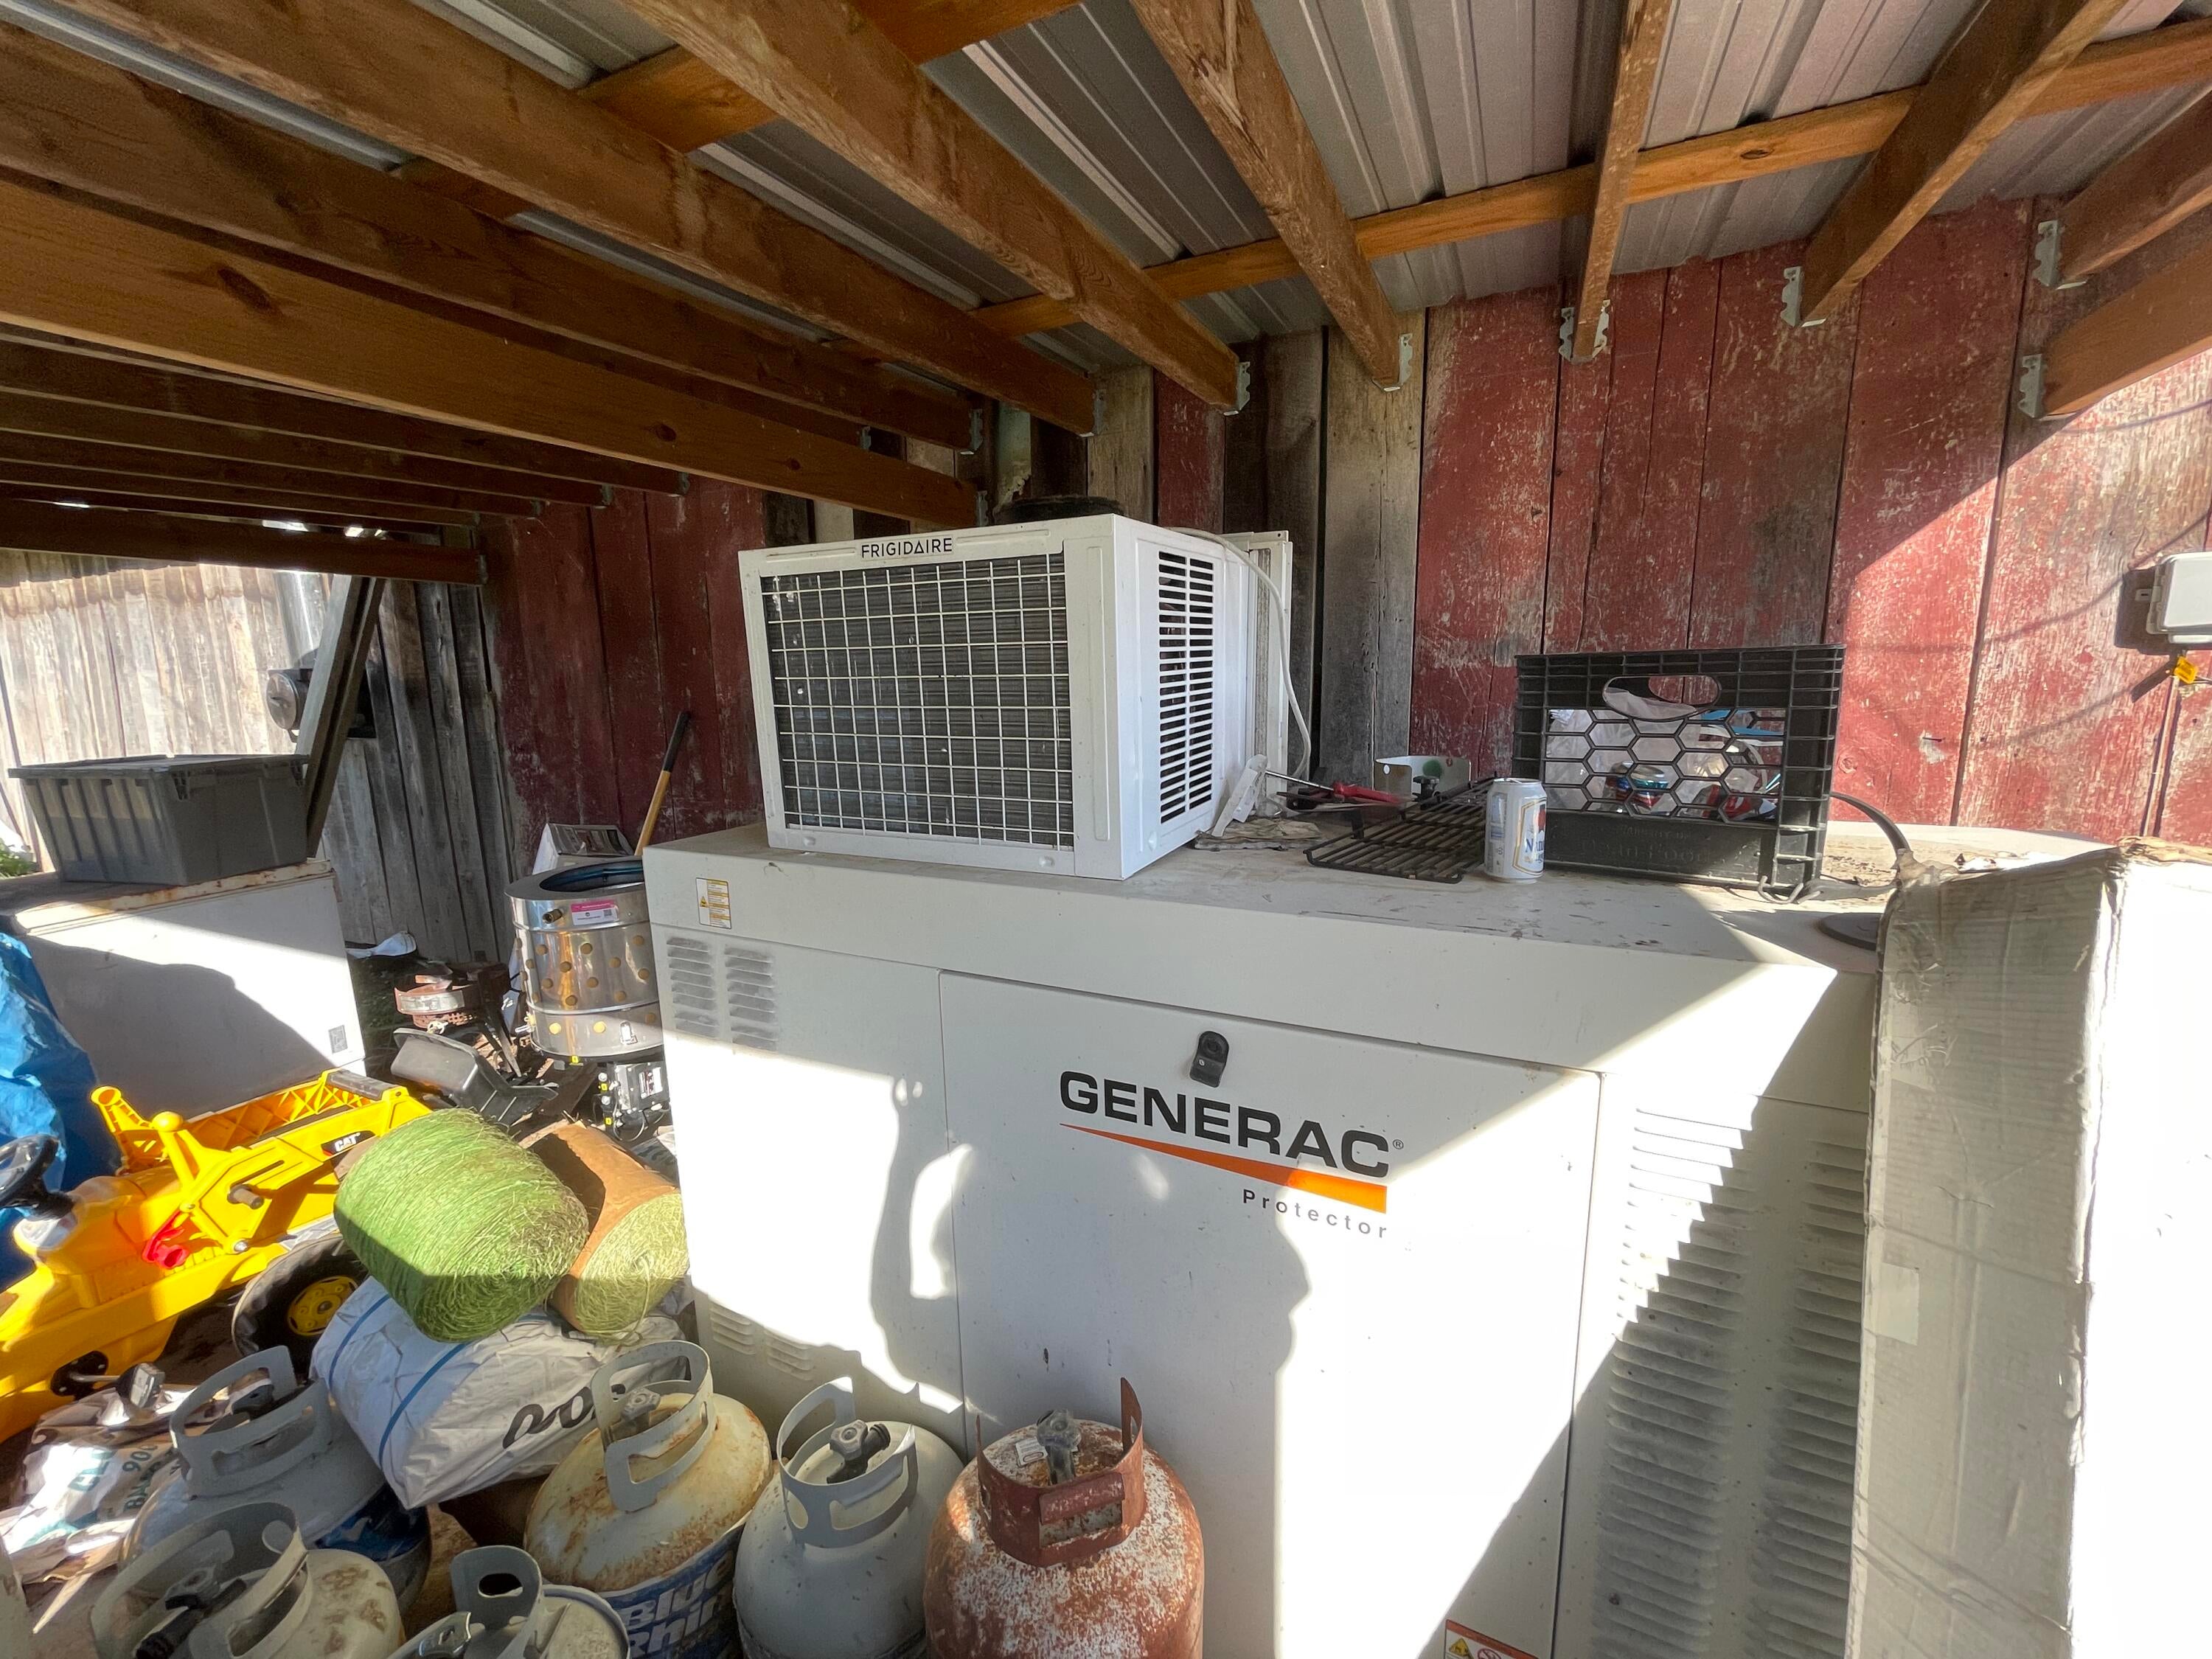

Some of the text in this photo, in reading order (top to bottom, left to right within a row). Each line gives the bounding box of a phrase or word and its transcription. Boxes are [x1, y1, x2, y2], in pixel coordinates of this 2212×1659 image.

[860, 538, 953, 558] FRIGIDAIRE
[335, 1133, 357, 1152] CAT
[1060, 1071, 1389, 1178] GENERAC
[1242, 1189, 1388, 1239] Protector
[618, 1549, 736, 1631] Blue
